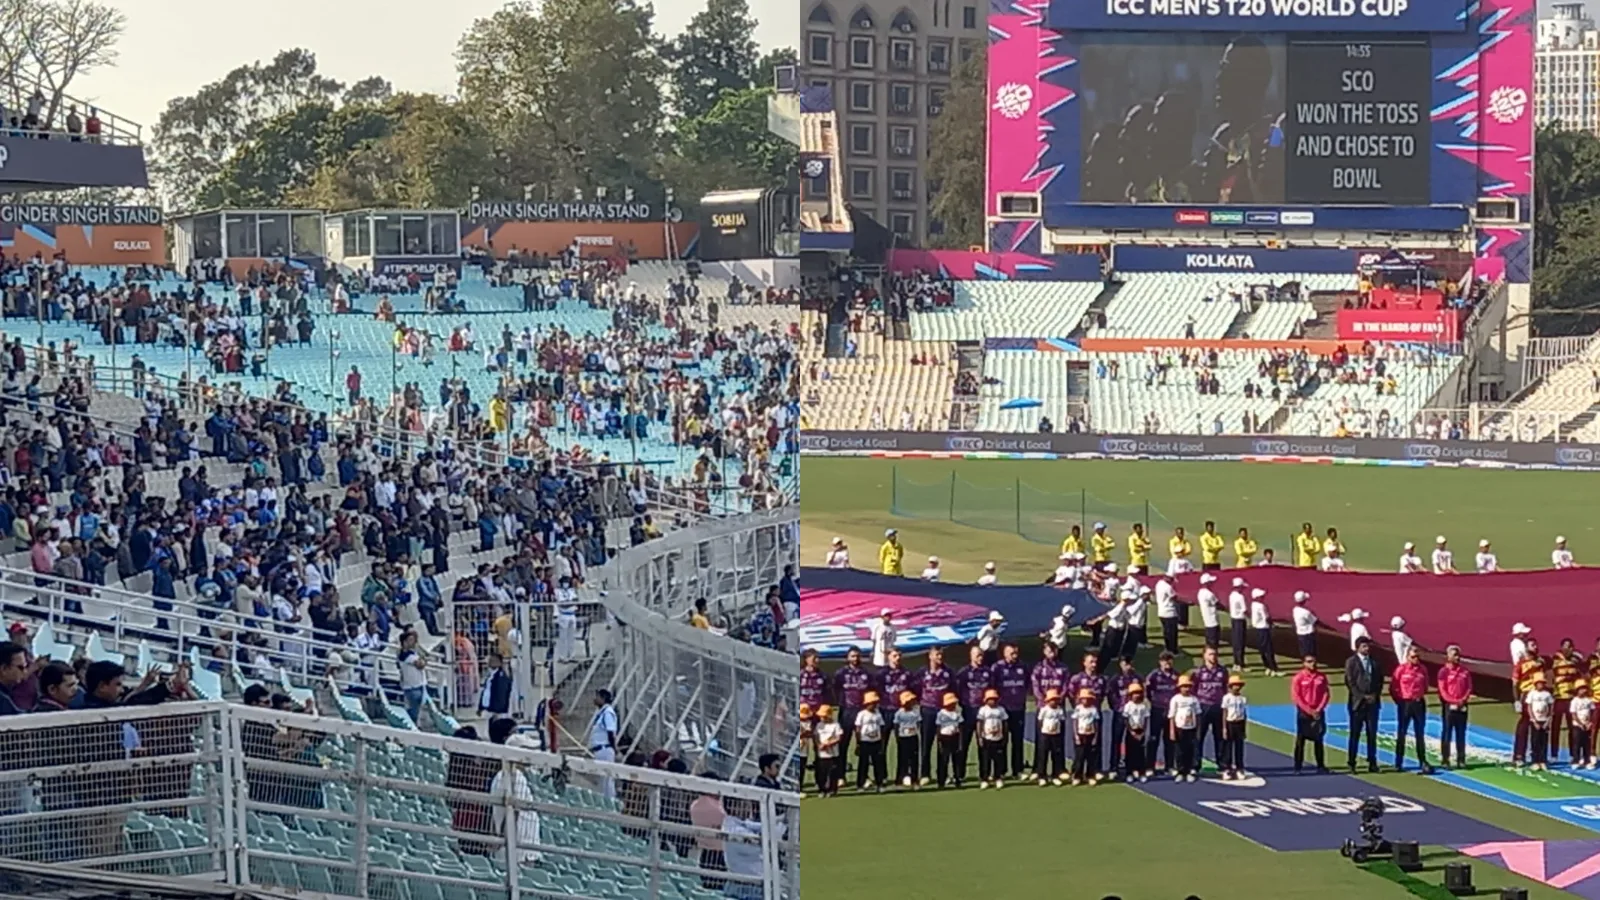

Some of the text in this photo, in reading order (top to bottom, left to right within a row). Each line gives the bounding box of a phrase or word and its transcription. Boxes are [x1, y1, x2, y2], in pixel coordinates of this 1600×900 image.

[1107, 0, 1408, 16] ICC MEN'S T20 WORLD CUP
[1341, 70, 1374, 92] SCO
[1296, 103, 1419, 124] WON THE TOSS
[1296, 135, 1414, 156] AND CHOSE TO
[1333, 167, 1381, 188] BOWL
[62, 207, 110, 224] SINGH
[113, 208, 160, 224] STAND
[471, 202, 650, 218] DHAN SINGH THAPA STAND
[1186, 254, 1255, 268] KOLKATA
[1364, 322, 1380, 332] THE
[830, 437, 864, 447] Cricket
[873, 437, 897, 448] Good
[985, 439, 1017, 449] Cricket
[1027, 439, 1051, 450] Good
[1138, 441, 1170, 451] Cricket
[1179, 441, 1204, 452] Good
[1290, 443, 1323, 453] Cricket
[1331, 443, 1356, 454] Good
[1441, 447, 1474, 457] Cricket
[1483, 447, 1508, 458] Good
[1253, 796, 1426, 816] WORD
